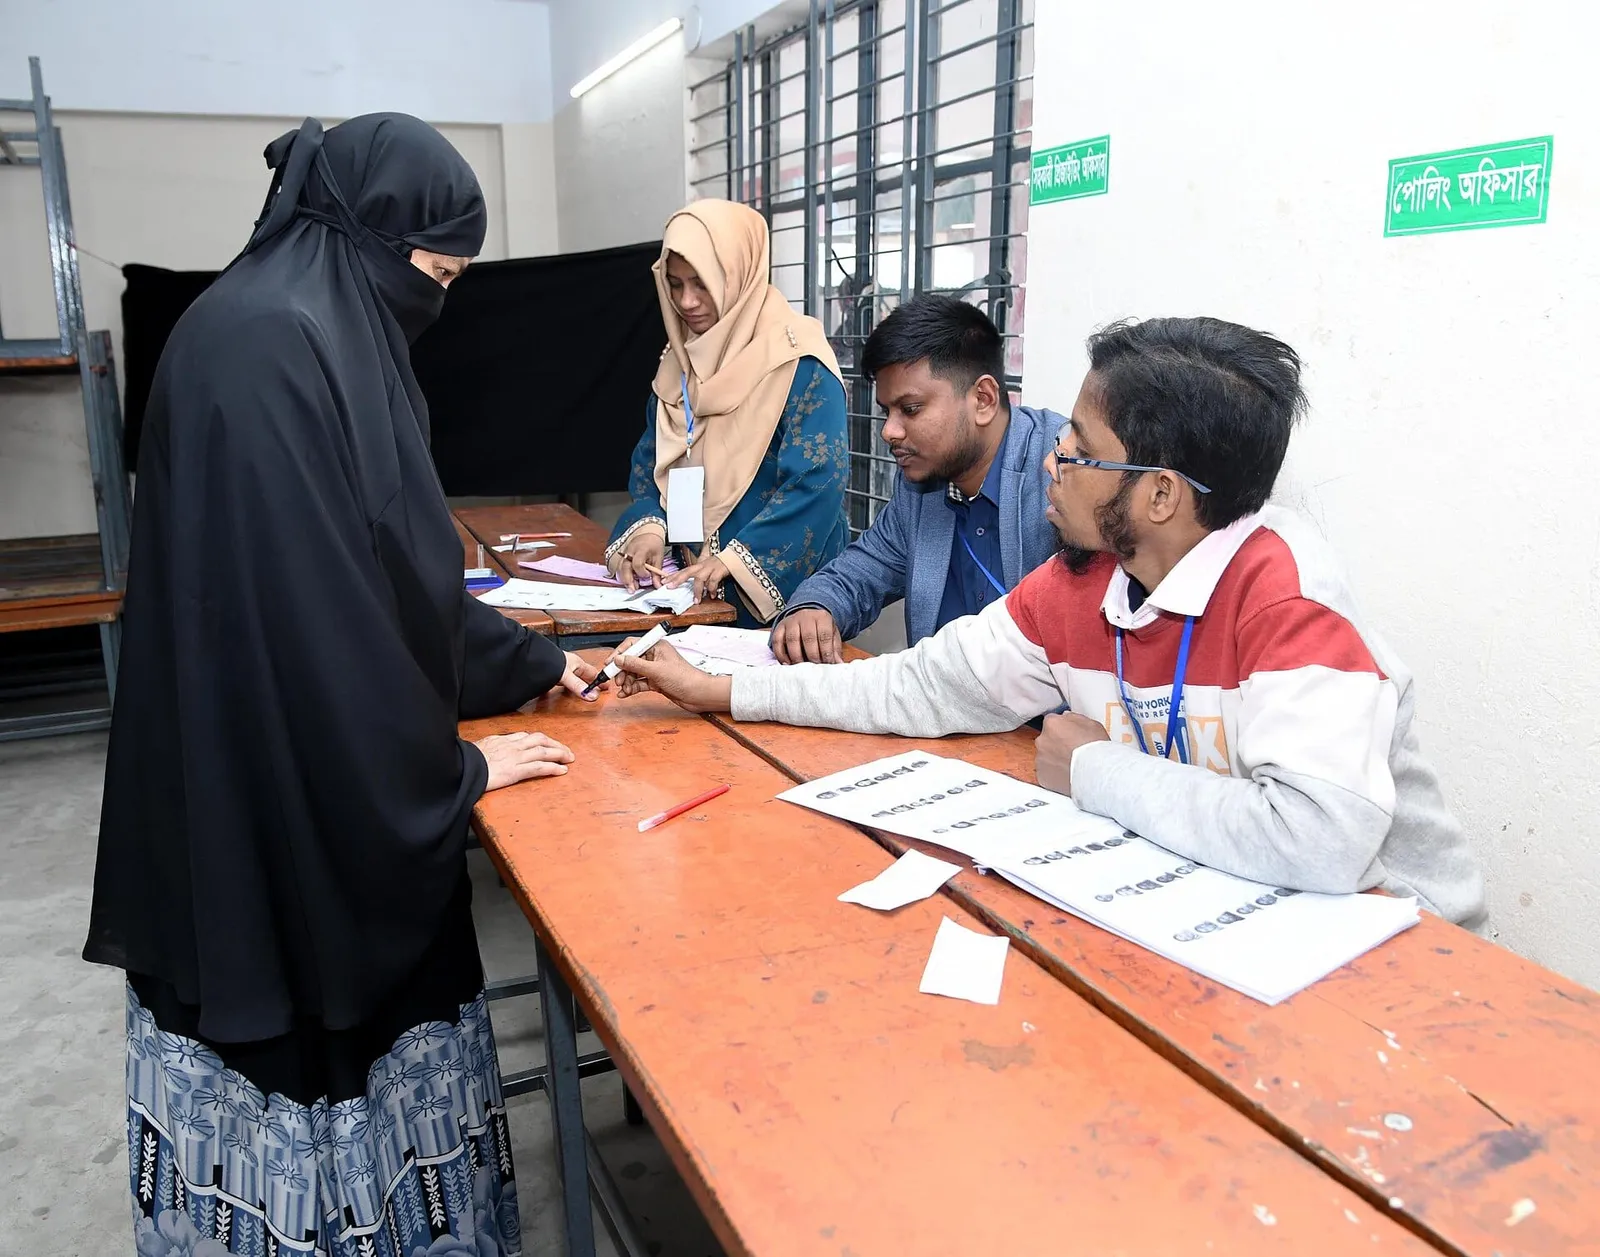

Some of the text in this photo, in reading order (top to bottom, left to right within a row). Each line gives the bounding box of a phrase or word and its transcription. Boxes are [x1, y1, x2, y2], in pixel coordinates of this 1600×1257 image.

[1393, 157, 1543, 214] পোলিং অফিসার
[1144, 696, 1172, 710] YORK
